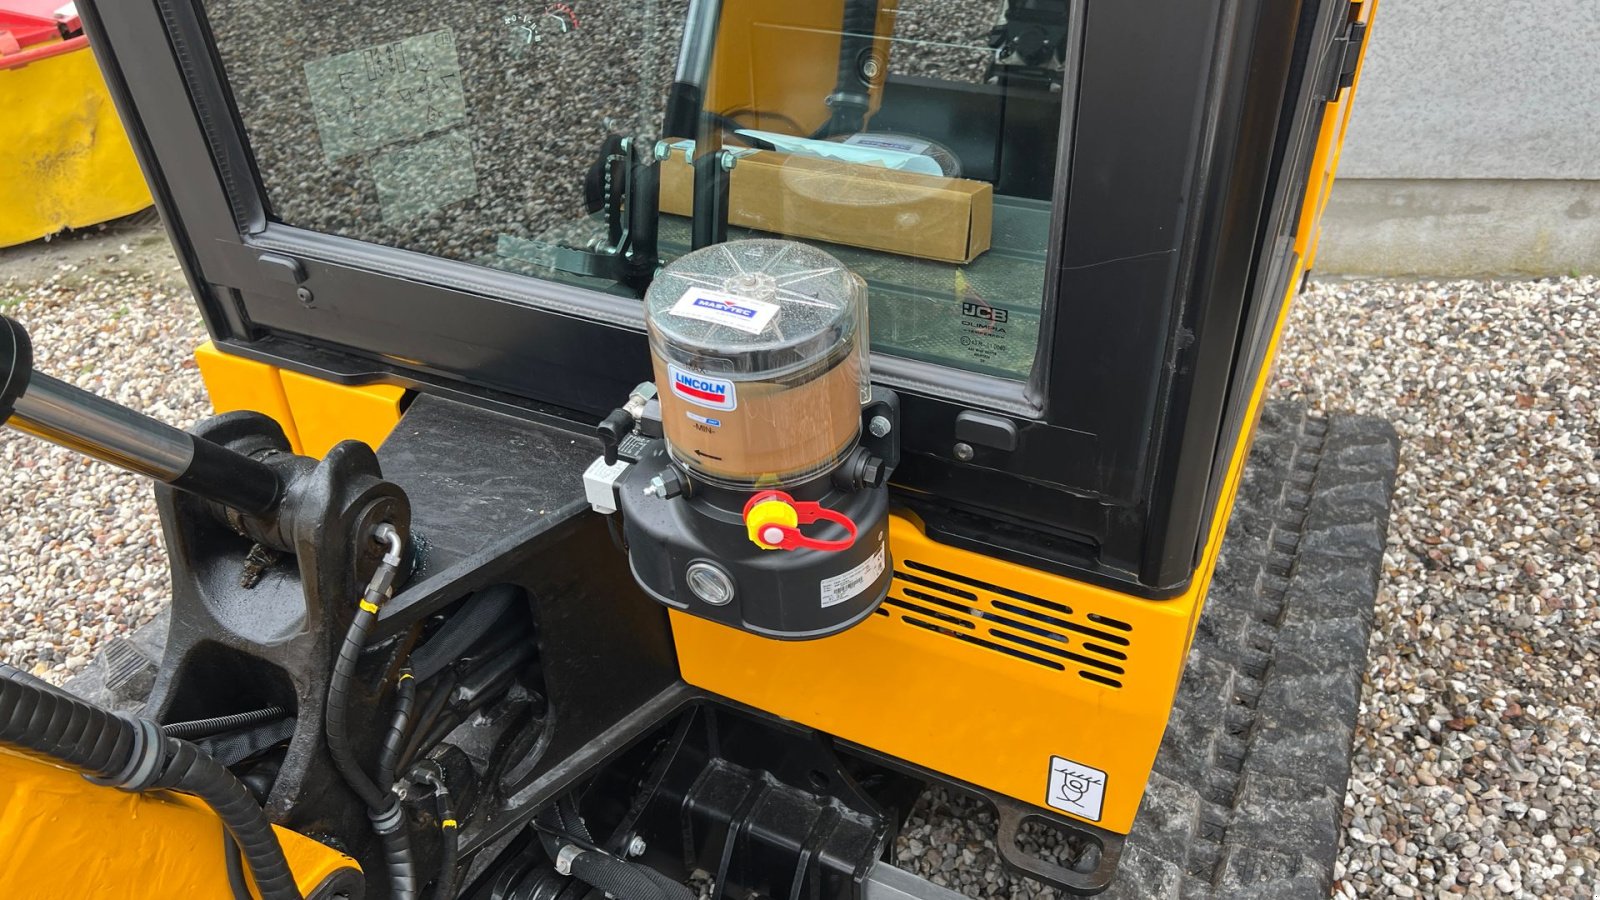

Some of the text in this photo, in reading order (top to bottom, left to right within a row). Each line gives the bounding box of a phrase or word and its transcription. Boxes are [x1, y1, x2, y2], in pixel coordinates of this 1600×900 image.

[698, 299, 752, 316] MASYTEC
[963, 303, 1007, 322] JCB
[676, 373, 725, 394] LINCOLN
